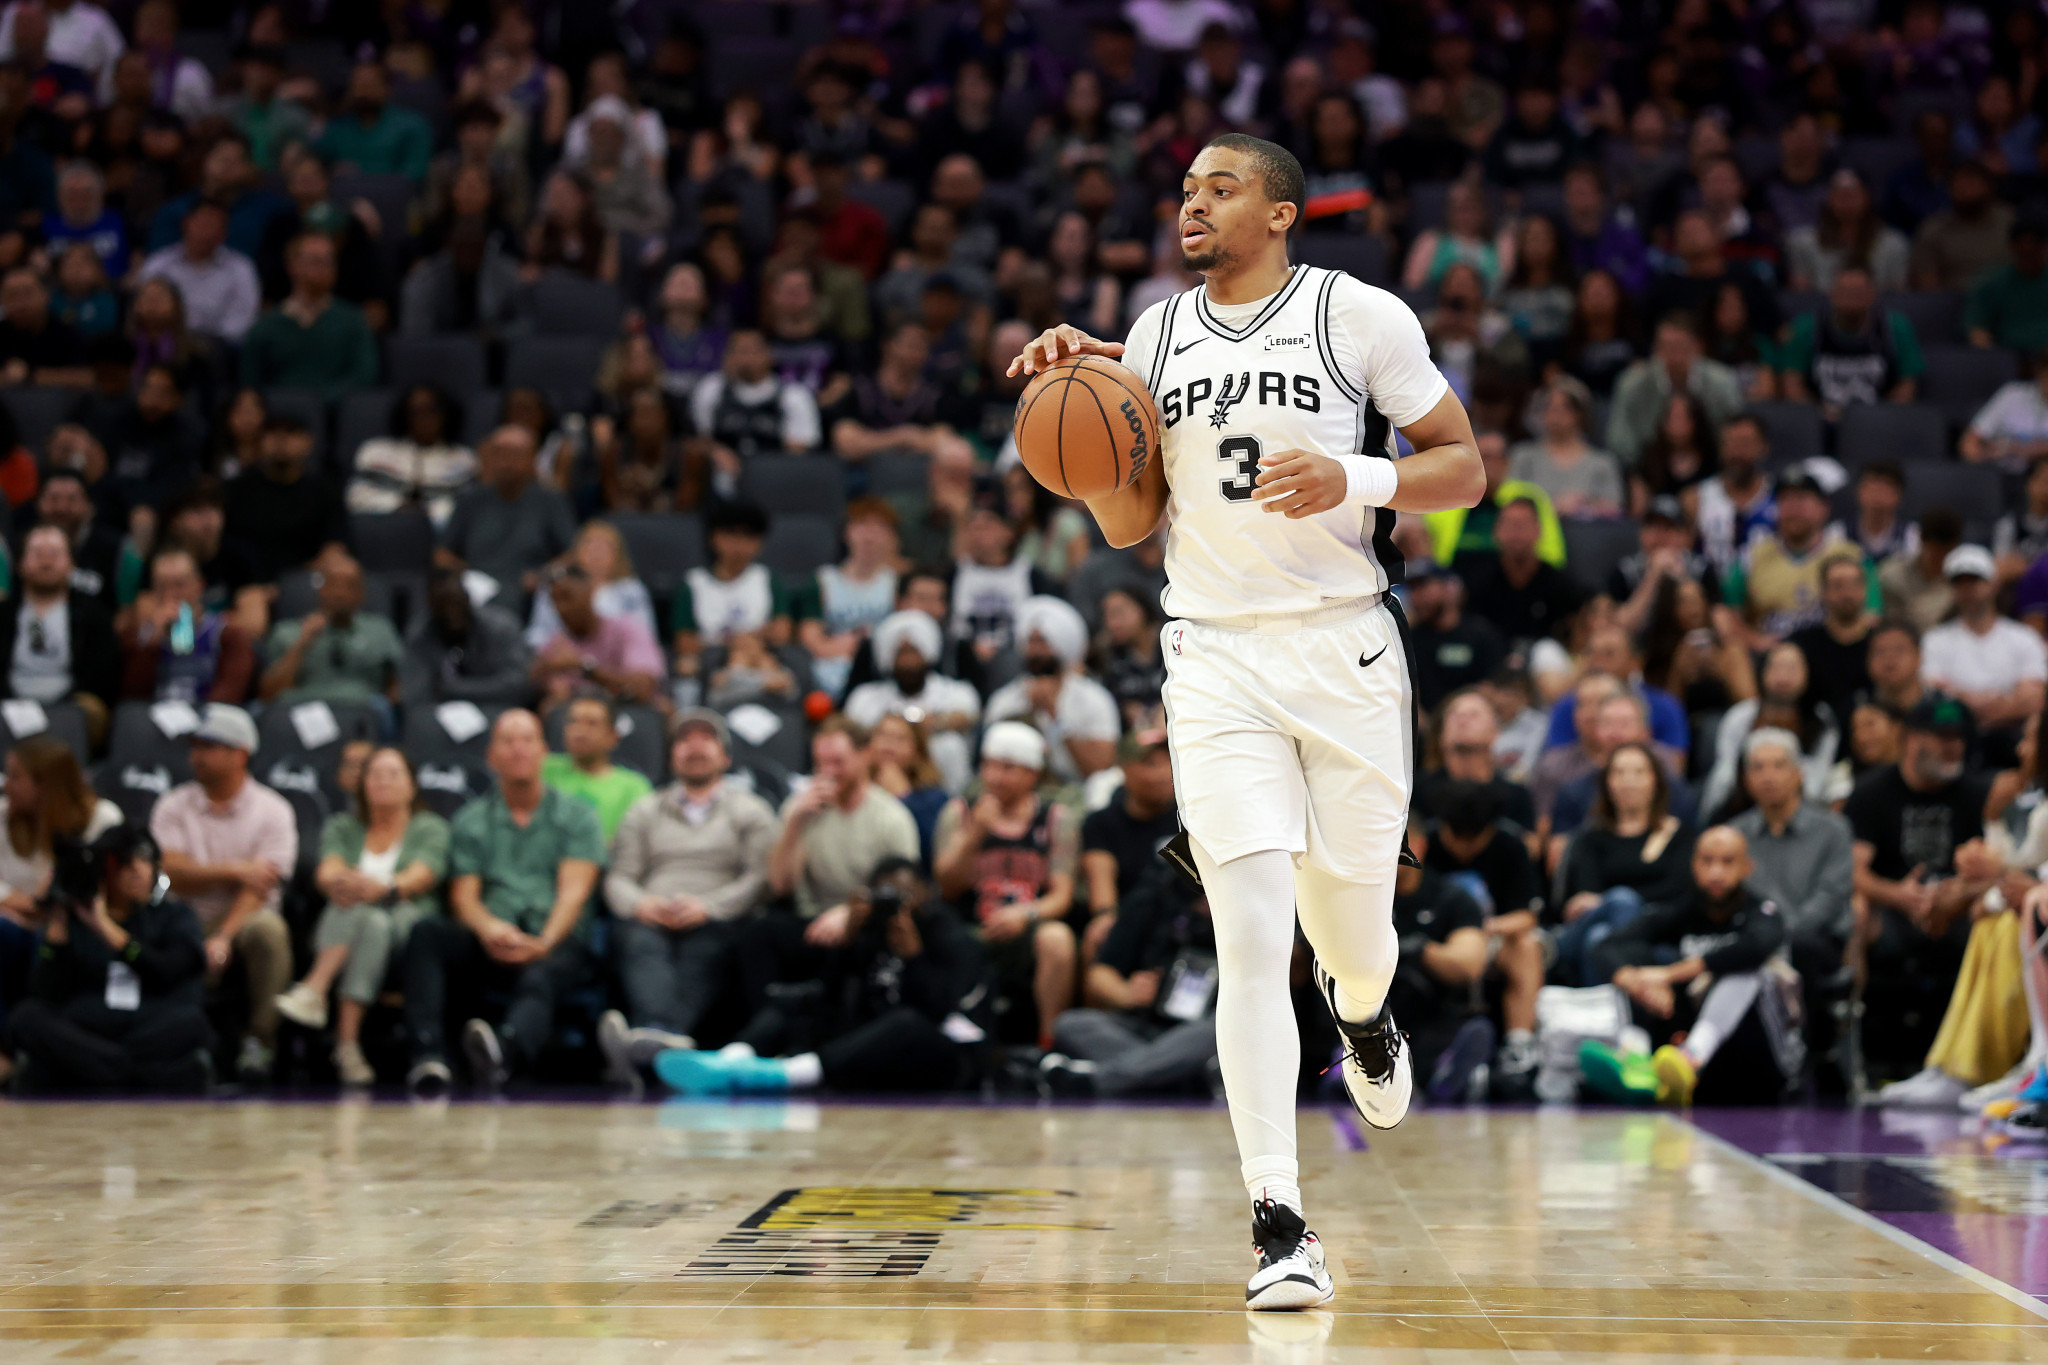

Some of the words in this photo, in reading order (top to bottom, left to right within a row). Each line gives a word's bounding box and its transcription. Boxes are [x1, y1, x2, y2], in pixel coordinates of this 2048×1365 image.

[1270, 337, 1305, 346] LEDGER
[1163, 371, 1321, 431] SPURS
[1216, 433, 1264, 504] 3
